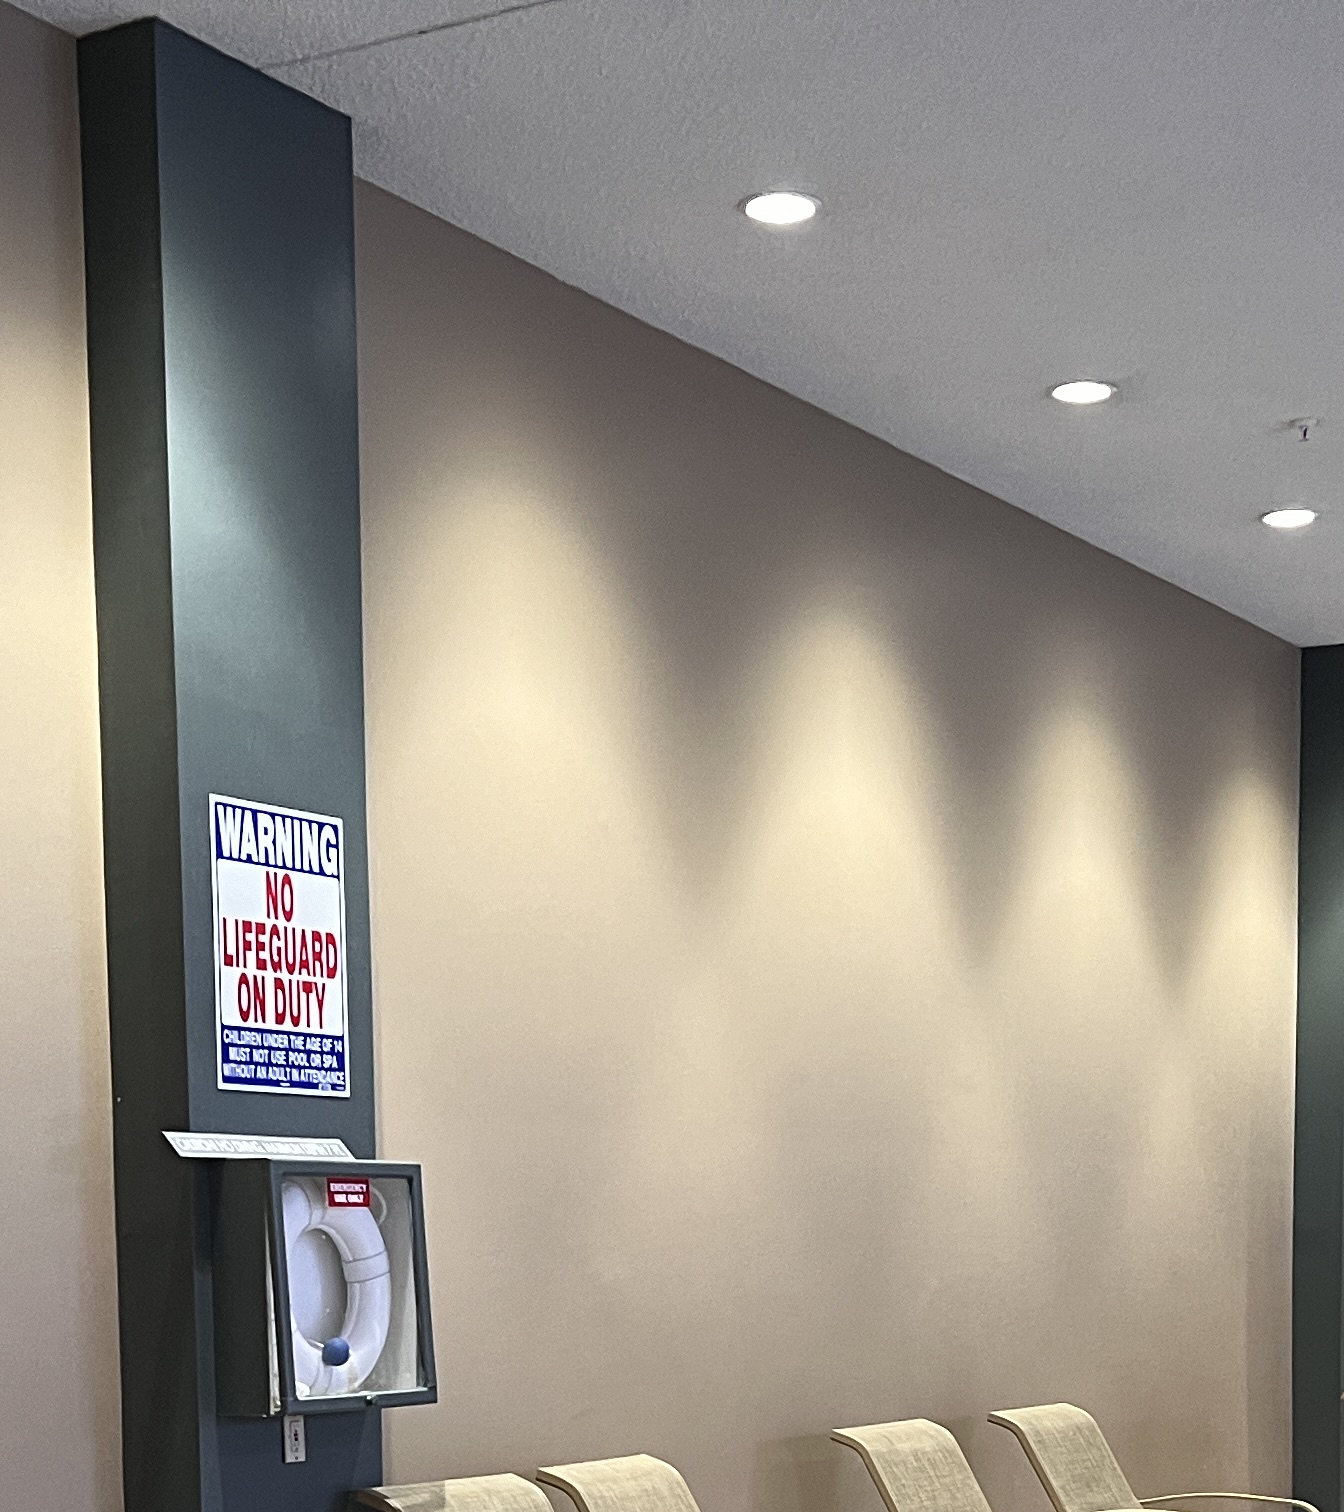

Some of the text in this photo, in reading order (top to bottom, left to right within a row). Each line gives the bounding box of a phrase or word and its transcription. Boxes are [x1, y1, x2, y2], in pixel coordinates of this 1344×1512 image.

[216, 804, 338, 876] WARNING
[265, 870, 294, 923] NO
[222, 916, 338, 980] LIFEGUARD
[237, 972, 326, 1029] ON DUTY
[223, 1029, 262, 1046] CHILDREN
[262, 1033, 289, 1049] UNDER
[290, 1035, 305, 1050] THE
[305, 1036, 322, 1051] AGE
[322, 1038, 333, 1052] OF
[229, 1046, 338, 1069] MUST NOT USE POOL OR SPA
[223, 1063, 345, 1085] WITHOUT AN ADULT IN ATTENDANCE
